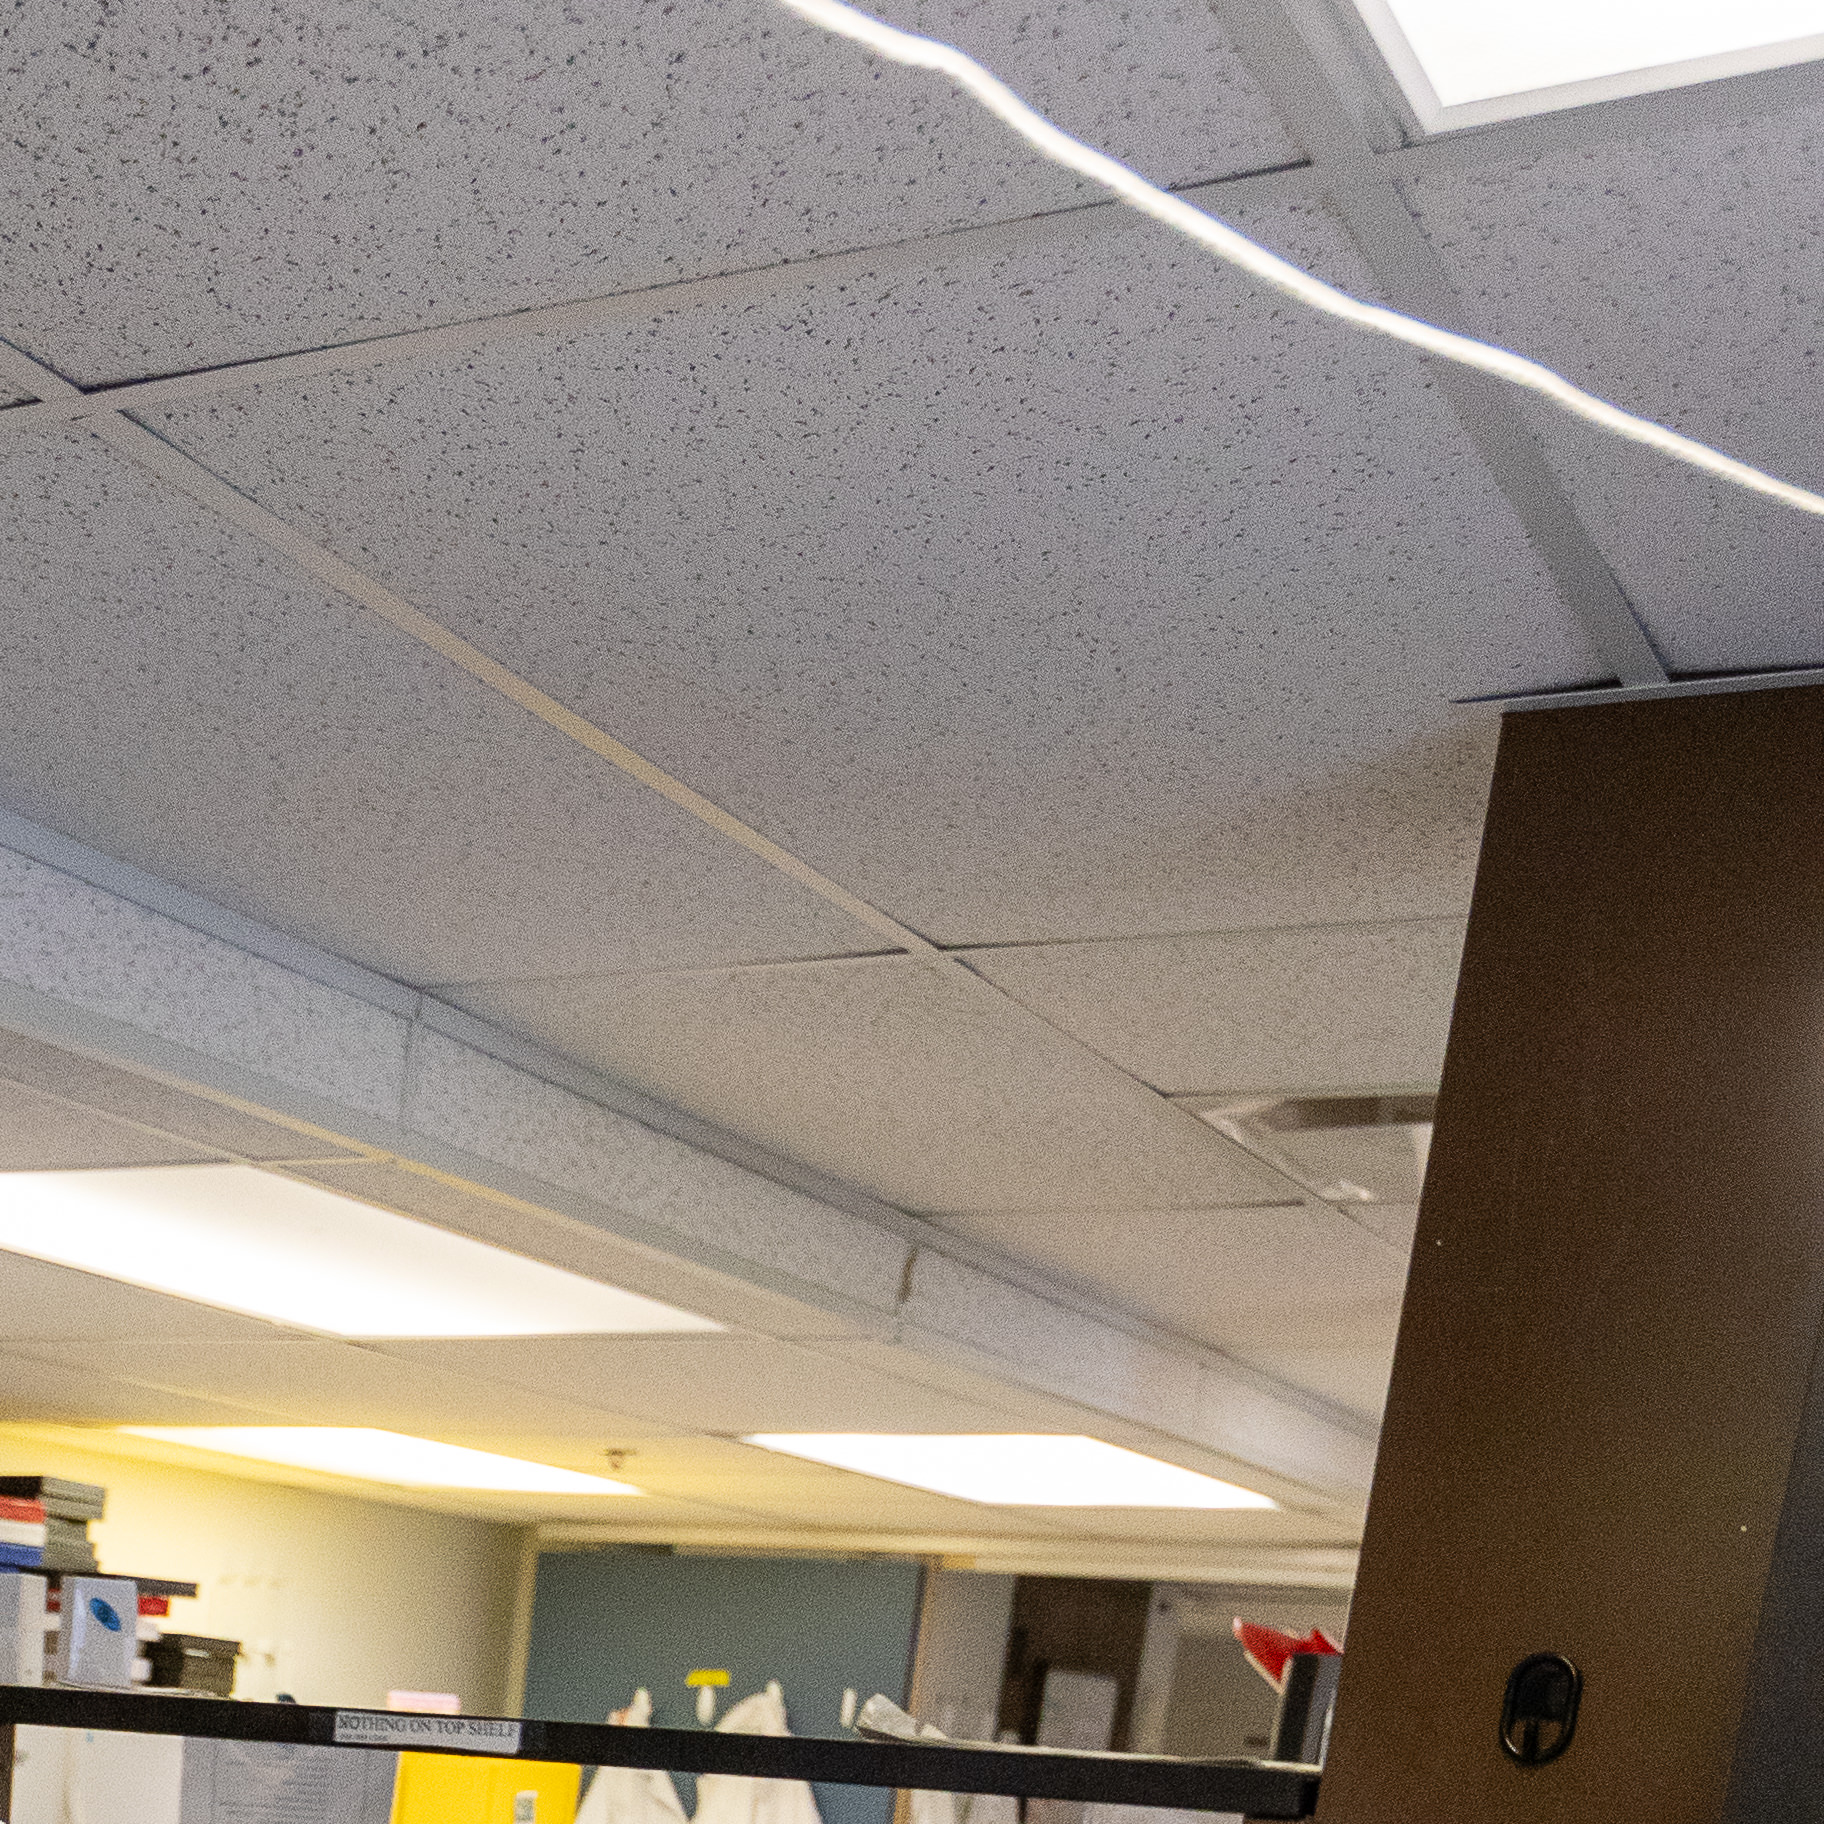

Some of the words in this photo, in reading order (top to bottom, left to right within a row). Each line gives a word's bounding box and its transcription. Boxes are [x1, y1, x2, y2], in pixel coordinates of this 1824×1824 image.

[338, 1714, 406, 1732] NOTHING
[409, 1718, 431, 1732] ON
[435, 1720, 465, 1735] TOP
[468, 1722, 518, 1737] SHELF
